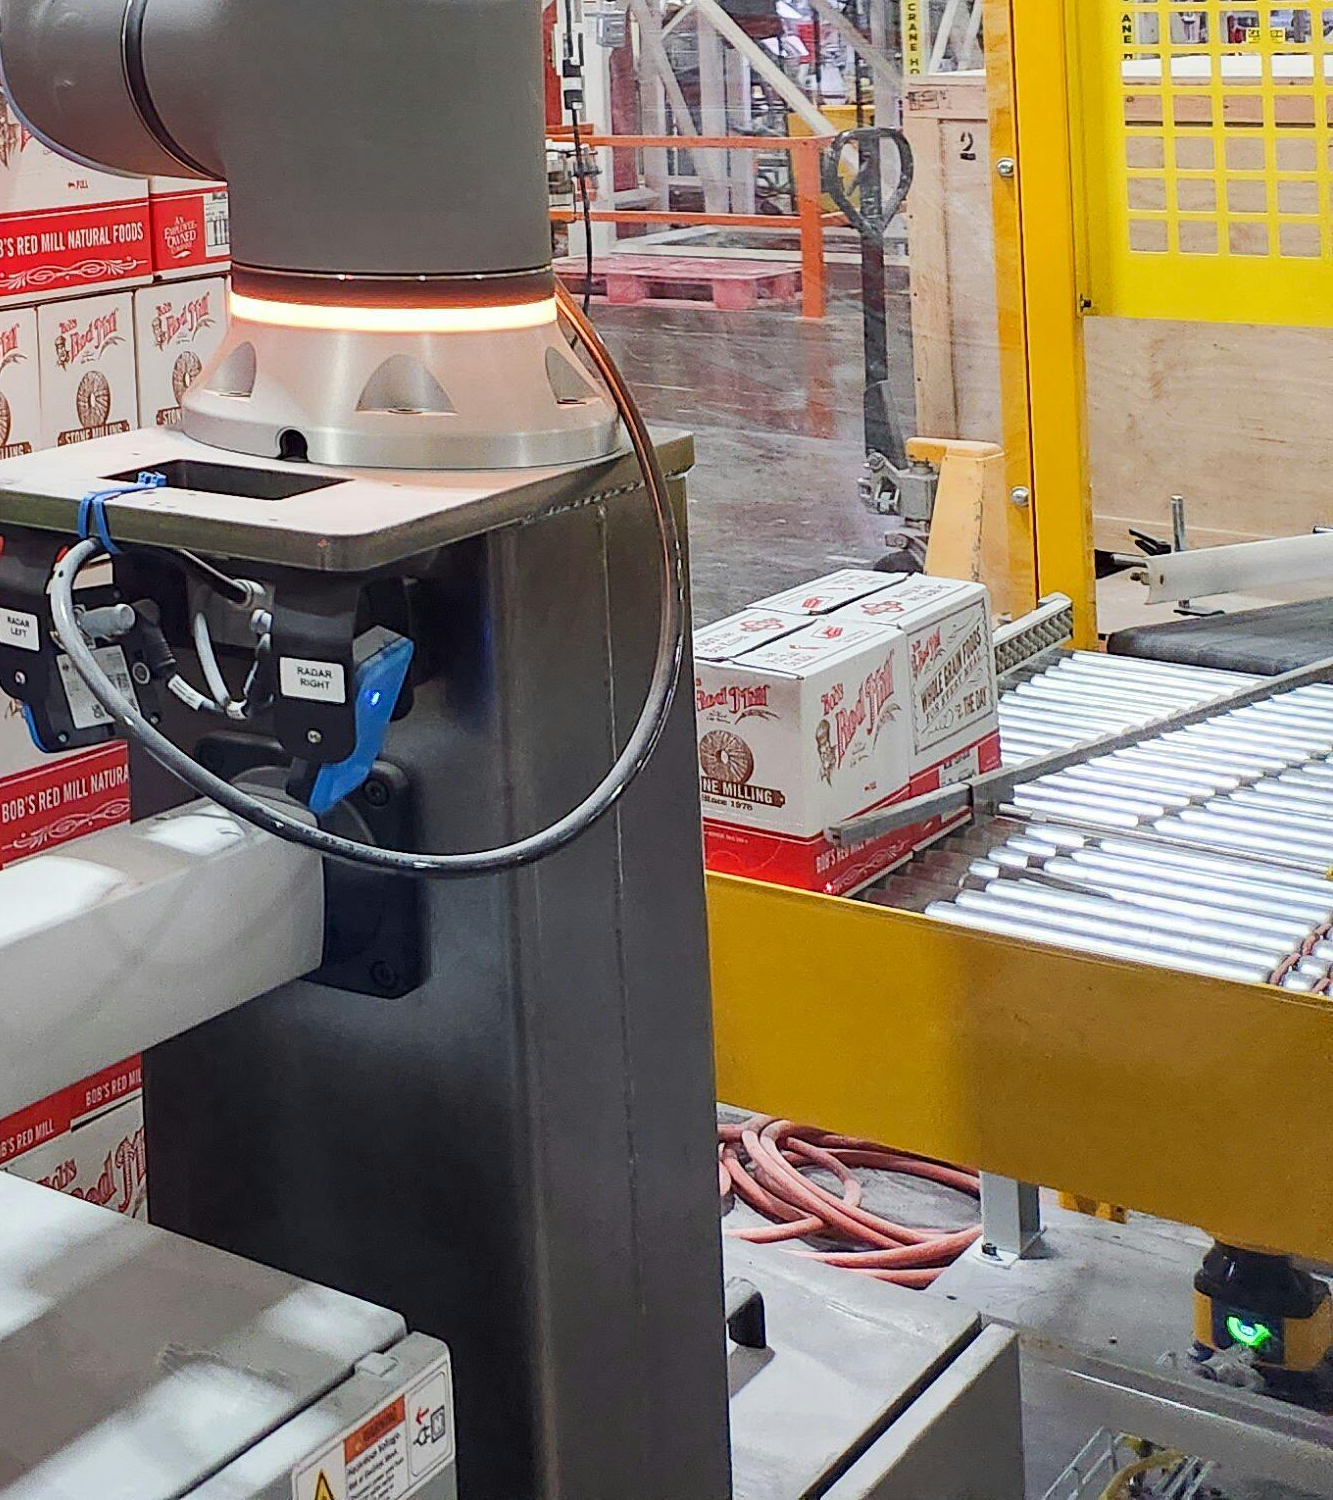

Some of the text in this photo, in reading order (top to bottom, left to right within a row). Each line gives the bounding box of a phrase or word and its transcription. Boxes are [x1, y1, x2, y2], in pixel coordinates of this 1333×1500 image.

[908, 3, 918, 51] CRANE
[7, 616, 30, 628] RADAR
[10, 627, 26, 638] LEFT
[297, 667, 332, 678] RADAR
[300, 678, 330, 689] RIGHT
[728, 684, 770, 714] Mill
[836, 681, 866, 770] Red
[865, 659, 895, 736] Mill
[723, 781, 772, 804] MILLING
[731, 799, 753, 811] 1978
[17, 1131, 33, 1151] RED
[35, 1119, 54, 1140] MILL
